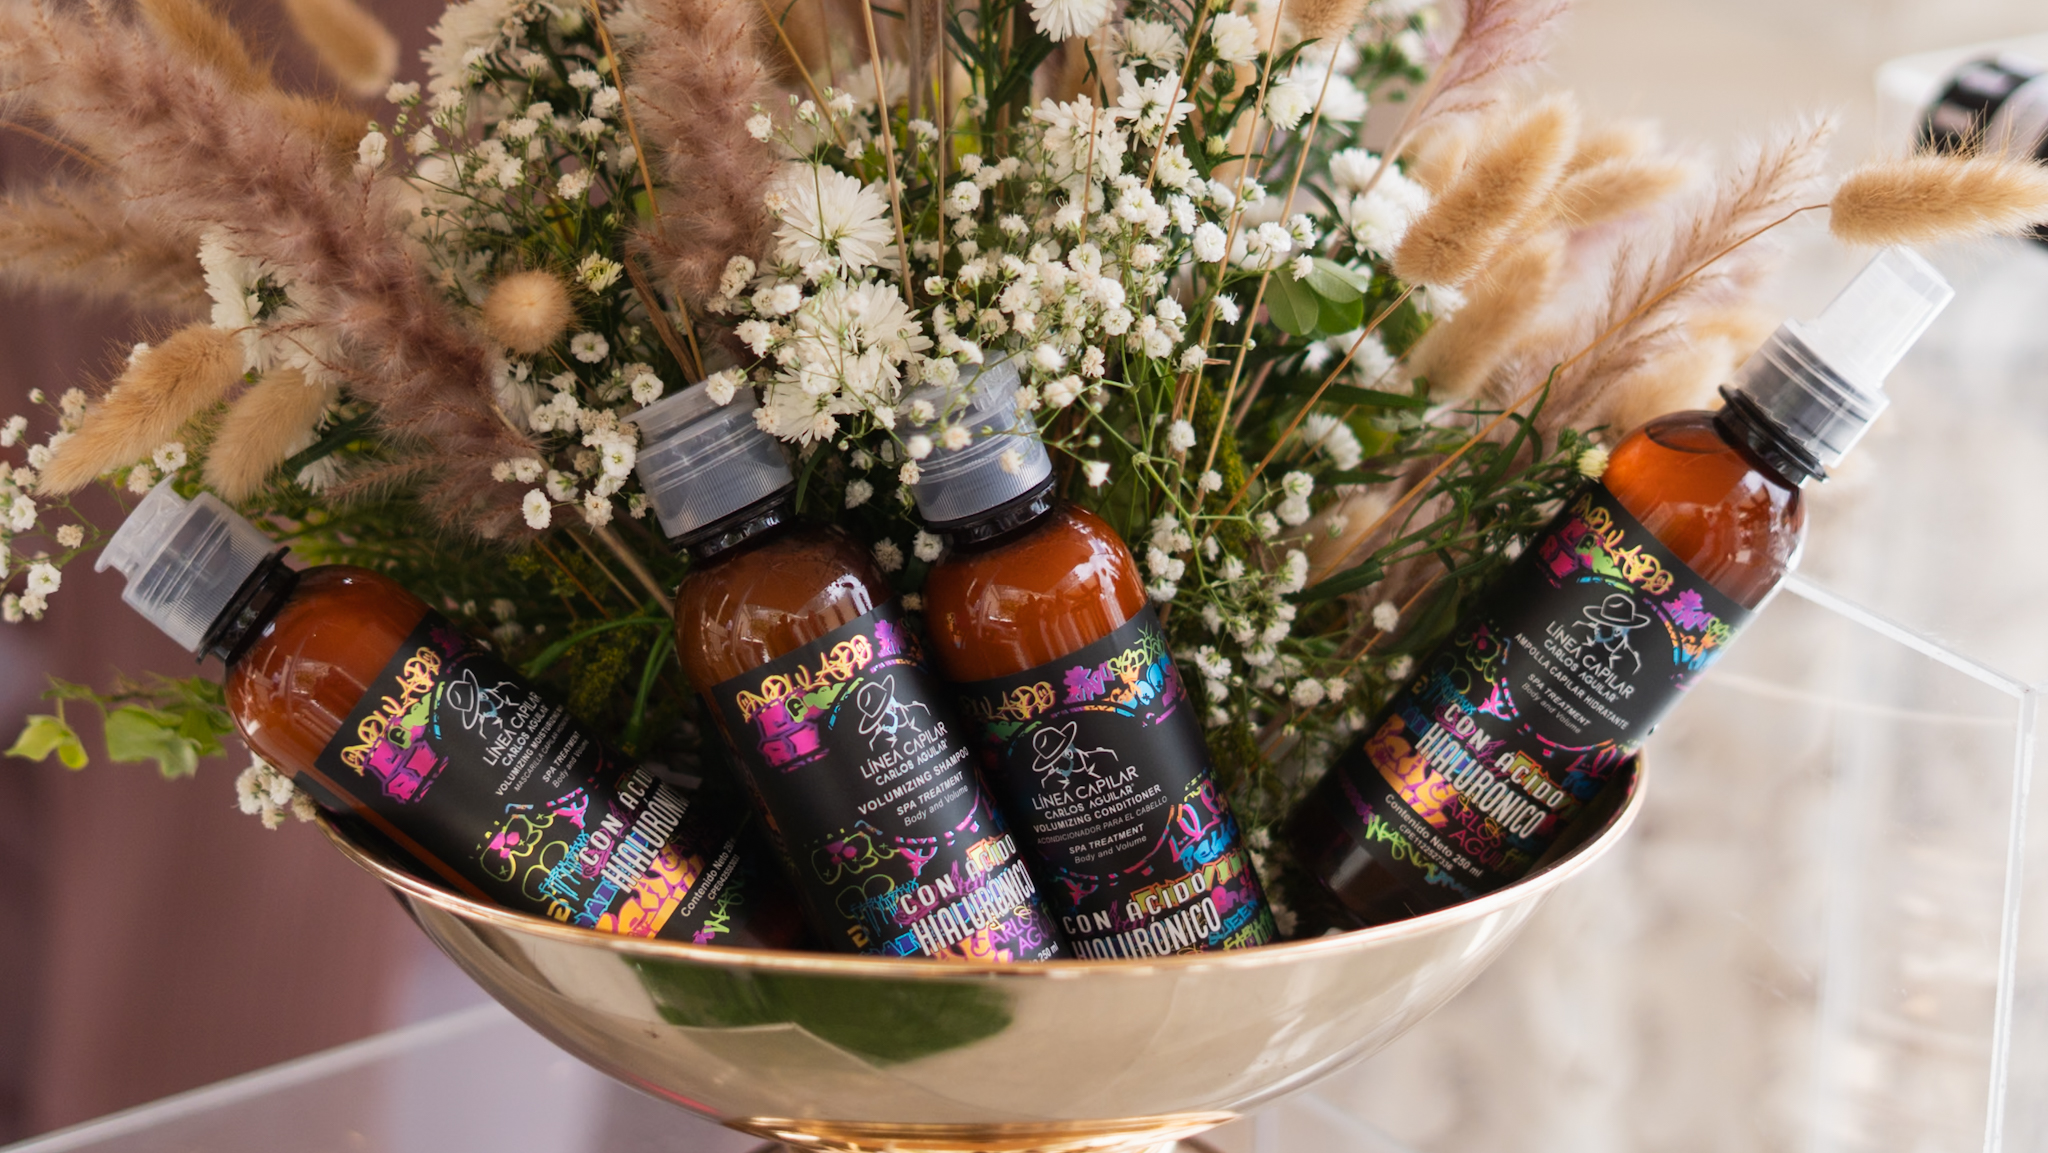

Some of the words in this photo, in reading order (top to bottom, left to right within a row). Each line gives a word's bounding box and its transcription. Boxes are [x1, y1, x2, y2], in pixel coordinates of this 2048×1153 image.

[1515, 633, 1550, 668] AMPOLLA
[1549, 666, 1585, 698] CAPILAR
[1583, 695, 1628, 729] HIDRATANTE
[1543, 638, 1578, 671] CARLOS
[1578, 671, 1617, 702] AGUILAR
[1546, 620, 1582, 658] LÍNEA
[1582, 654, 1634, 698] CAPILAR
[1521, 682, 1540, 700] Body
[1539, 700, 1556, 713] and
[1555, 711, 1581, 733] Volume
[1527, 673, 1544, 689] SPA
[1544, 688, 1590, 725] TREATMENT
[482, 728, 516, 765] LÍNEA
[510, 692, 538, 728] CAPILAR
[501, 731, 529, 766] CARLOS
[860, 746, 903, 778] LÍNEA
[903, 721, 947, 755] CAPILAR
[1444, 703, 1490, 751] CON
[1494, 752, 1563, 806] ÁCIDO
[495, 748, 533, 795] VOLUMIZING
[513, 753, 543, 791] MASCARILLA
[540, 731, 557, 754] CAPILAR
[542, 766, 556, 782] SPA
[552, 731, 578, 766] TREATMENT
[551, 769, 568, 788] Body
[565, 755, 576, 770] and
[572, 739, 589, 757] Volume
[858, 769, 934, 814] VOLUMIZING
[932, 747, 968, 776] SHAMPOO
[875, 759, 914, 785] CARLOS
[1414, 722, 1547, 840] HIALURÓNICO
[896, 799, 917, 815] SPA
[917, 771, 962, 803] TREATMENT
[903, 809, 926, 826] Body
[928, 798, 944, 813] and
[943, 785, 967, 803] Volume
[1031, 791, 1073, 809] LÍNEA
[1075, 765, 1138, 798] CAPILAR
[1033, 813, 1091, 832] VOLUMIZING
[1094, 783, 1161, 818] CONDITIONER
[1044, 802, 1084, 819] CARLOS
[1089, 783, 1133, 808] AGUILAR
[576, 813, 623, 865] CON
[1036, 823, 1102, 845] ACONDICIONADOR
[1102, 816, 1123, 829] PARA
[1124, 812, 1134, 821] EL
[1135, 795, 1167, 816] CABELLO
[1068, 844, 1086, 854] SPA
[1088, 823, 1143, 848] TREATMENT
[1385, 794, 1429, 838] Contenido
[1429, 835, 1452, 856] Neto
[1452, 853, 1470, 869] 250
[1468, 866, 1482, 877] ml
[897, 873, 955, 914] CON
[964, 834, 1015, 881] ÁCIDO
[1074, 853, 1095, 863] Body
[1097, 846, 1113, 857] and
[1115, 835, 1146, 851] Volume
[681, 872, 716, 917] Contenido
[712, 851, 728, 870] Neto
[910, 858, 1035, 957] HIALURÓNICO
[1063, 910, 1111, 933] CON
[1126, 872, 1207, 921] ÁCIDO
